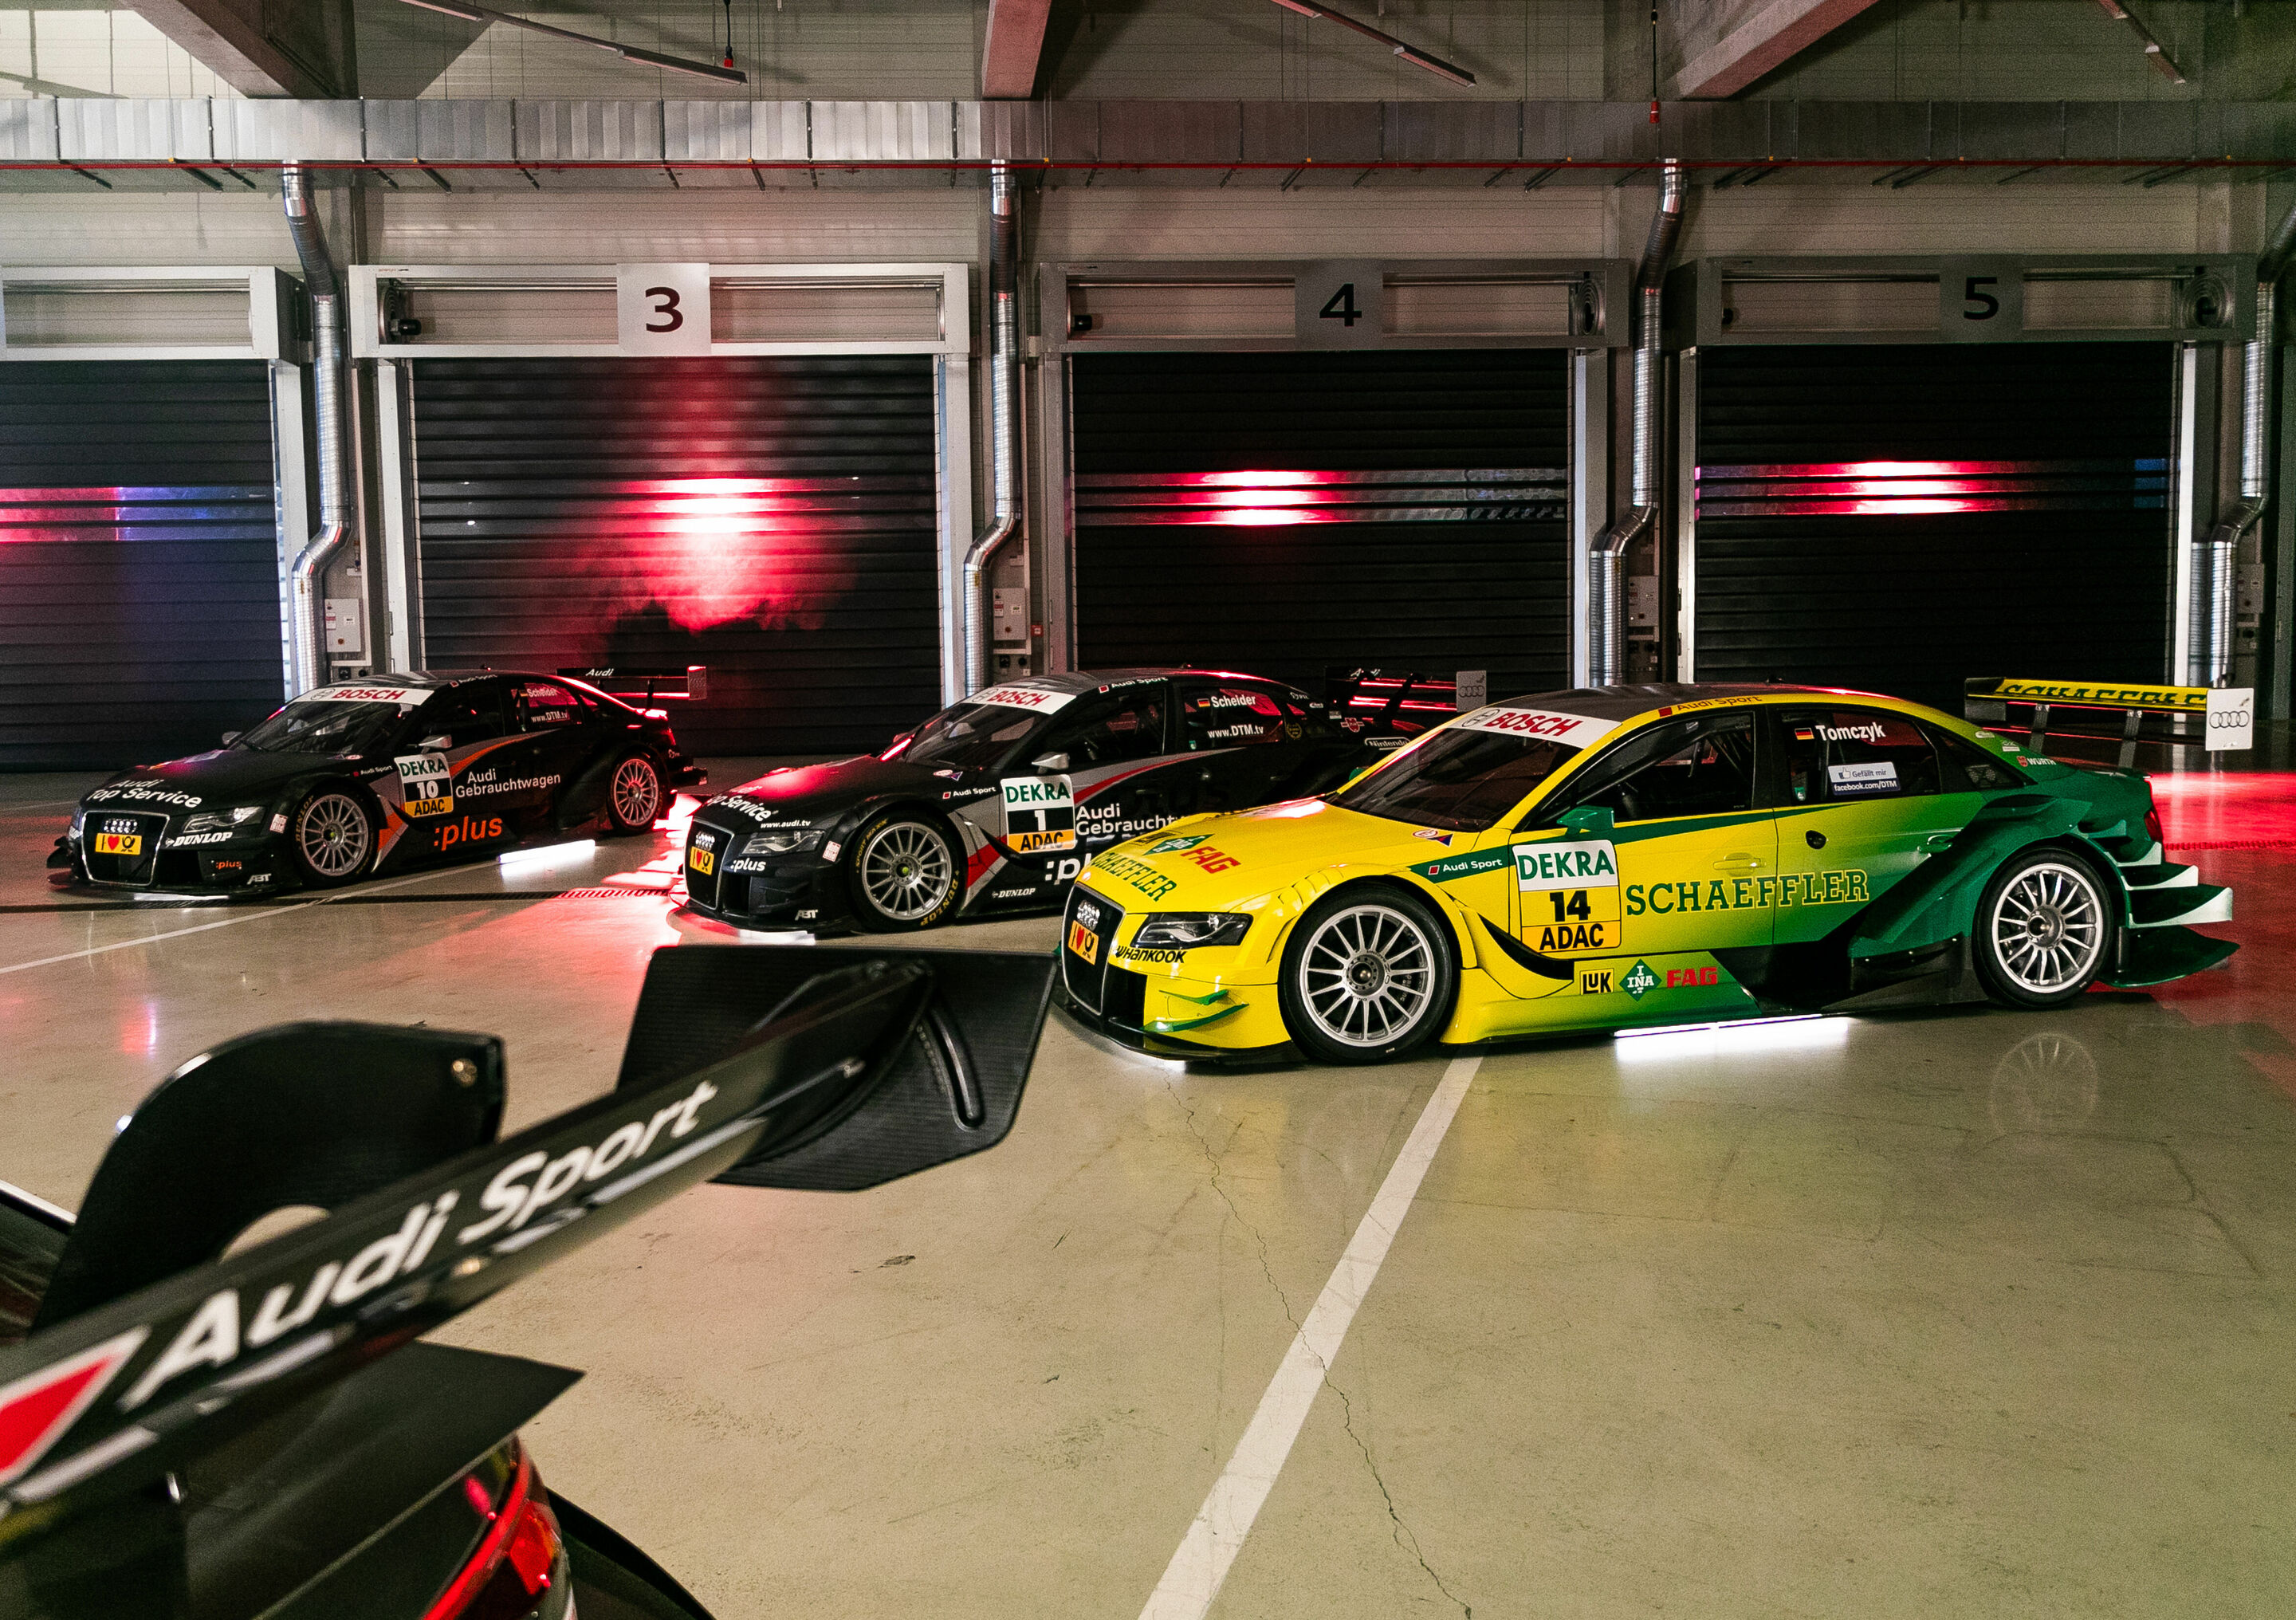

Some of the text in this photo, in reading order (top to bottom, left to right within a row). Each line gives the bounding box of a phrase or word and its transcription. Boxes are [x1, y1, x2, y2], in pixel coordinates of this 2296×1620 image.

[1319, 282, 1362, 327] 4
[1964, 277, 1999, 320] 5
[645, 286, 684, 333] 3
[585, 668, 615, 677] Audi
[1111, 679, 1135, 688] Audi
[332, 689, 407, 700] BOSCH
[987, 690, 1051, 706] BOSCH
[1210, 694, 1256, 708] Scheider
[1677, 695, 1763, 710] Audi Sport
[1208, 724, 1264, 738] www.DTM.tv
[1484, 712, 1583, 737] BOSCH
[1815, 722, 1886, 742] Tomczyk
[399, 759, 448, 777] DEKRA
[467, 769, 497, 784] Audi
[108, 779, 164, 788] Audi
[417, 780, 438, 799] 10
[455, 774, 561, 798] Gebrauchtwagen
[1005, 782, 1071, 804] DEKRA
[1834, 781, 1897, 792] facebook.com/DTM
[86, 788, 202, 808] Top Service
[414, 800, 445, 816] ADAC
[721, 795, 772, 822] Service
[1075, 803, 1120, 820] Audi
[760, 820, 811, 828] www.audi.tv
[1034, 810, 1046, 831] 1
[1075, 814, 1178, 836] Gebraucht
[173, 832, 233, 847] DUNLOP
[1020, 832, 1064, 851] ADAC
[1180, 846, 1242, 874] FAG
[1442, 859, 1503, 872] Audi Sport
[1517, 849, 1614, 880] DEKRA
[246, 873, 272, 885] ABT
[998, 887, 1036, 898] DUNLOP
[1626, 868, 1869, 916] SCHAEFFLER
[920, 879, 959, 926] DUNLOP
[1550, 891, 1591, 922] 14
[1539, 923, 1604, 950] ADAC
[1627, 975, 1654, 988] INA
[1666, 966, 1718, 989] FAG
[116, 1080, 720, 1412] Audi Sport
